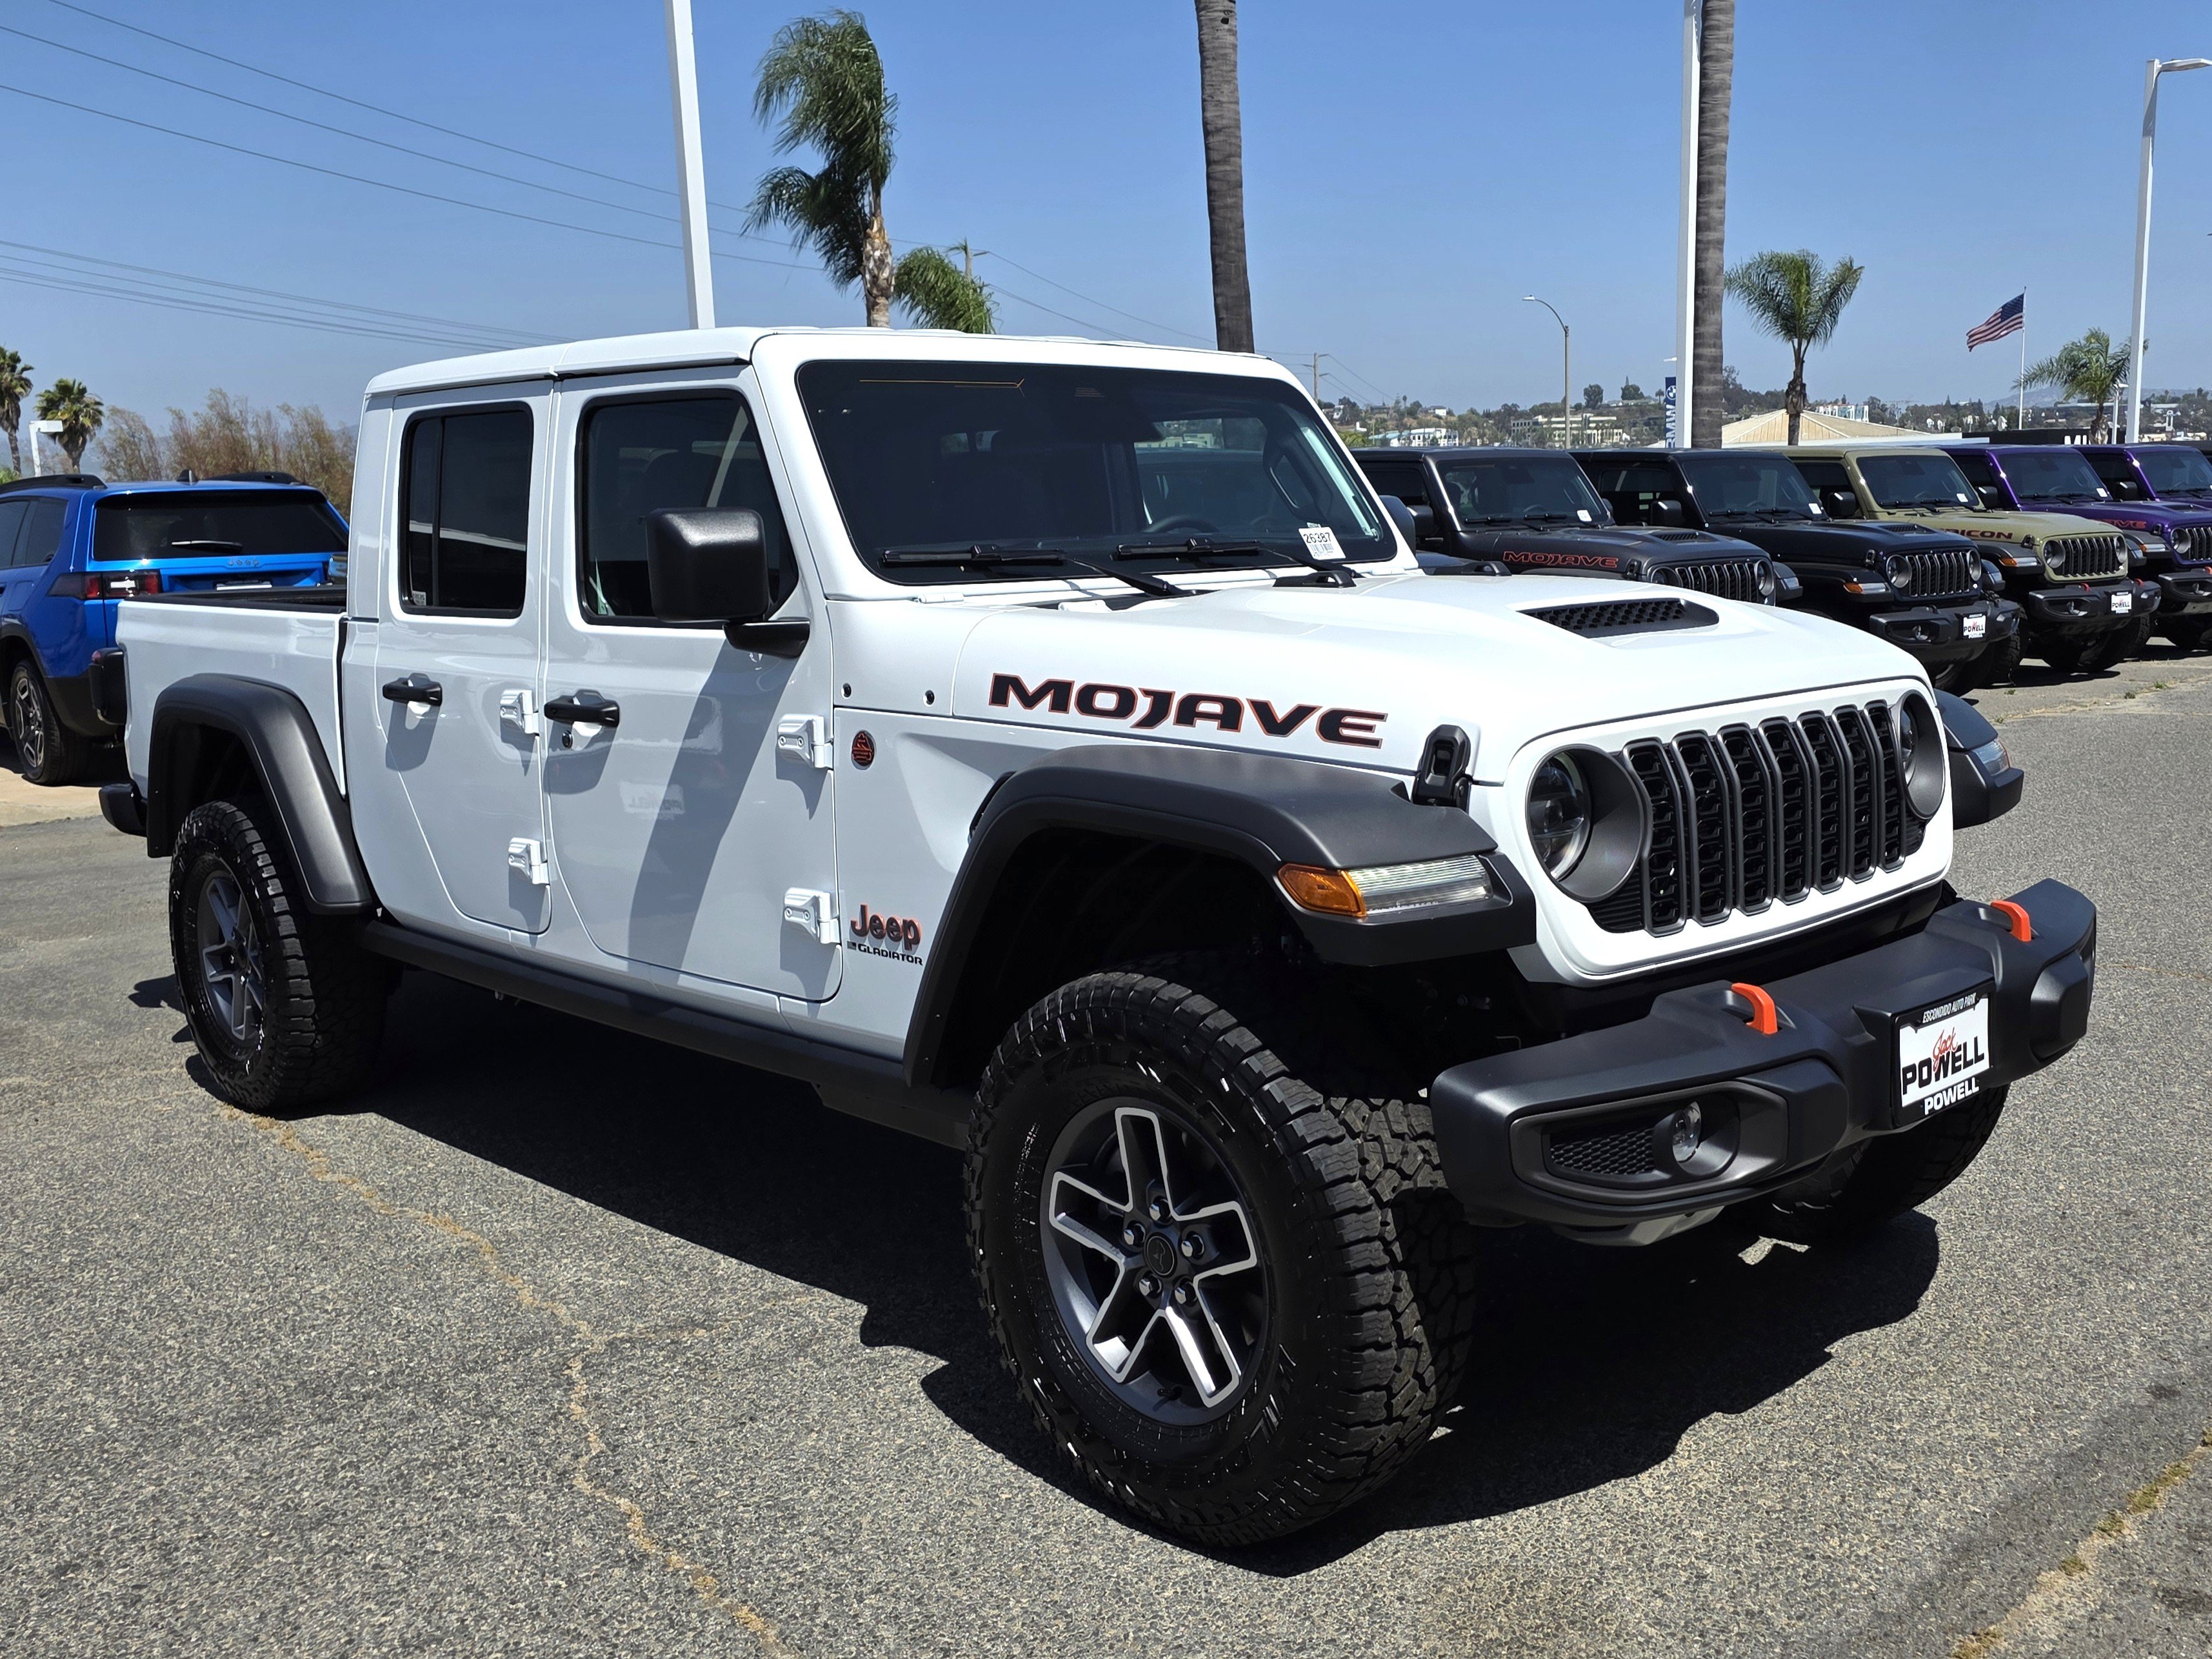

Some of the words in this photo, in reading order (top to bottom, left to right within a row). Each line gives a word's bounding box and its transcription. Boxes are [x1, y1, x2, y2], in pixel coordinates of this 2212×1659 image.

[1303, 532, 1331, 543] 26387
[1940, 528, 2013, 539] ICON
[1502, 551, 1619, 568] MOJAVE
[988, 672, 1389, 749] MOJAVE
[851, 903, 922, 952] Jeep
[858, 944, 924, 966] GLADIATOR
[1922, 1004, 1952, 1023] ESCONDIDO
[1951, 998, 1965, 1014] AUTO
[1963, 992, 1977, 1008] PARK
[1902, 1036, 1985, 1095] POWELL
[1932, 1026, 1958, 1071] Jack
[1924, 1077, 1980, 1116] POWELL
